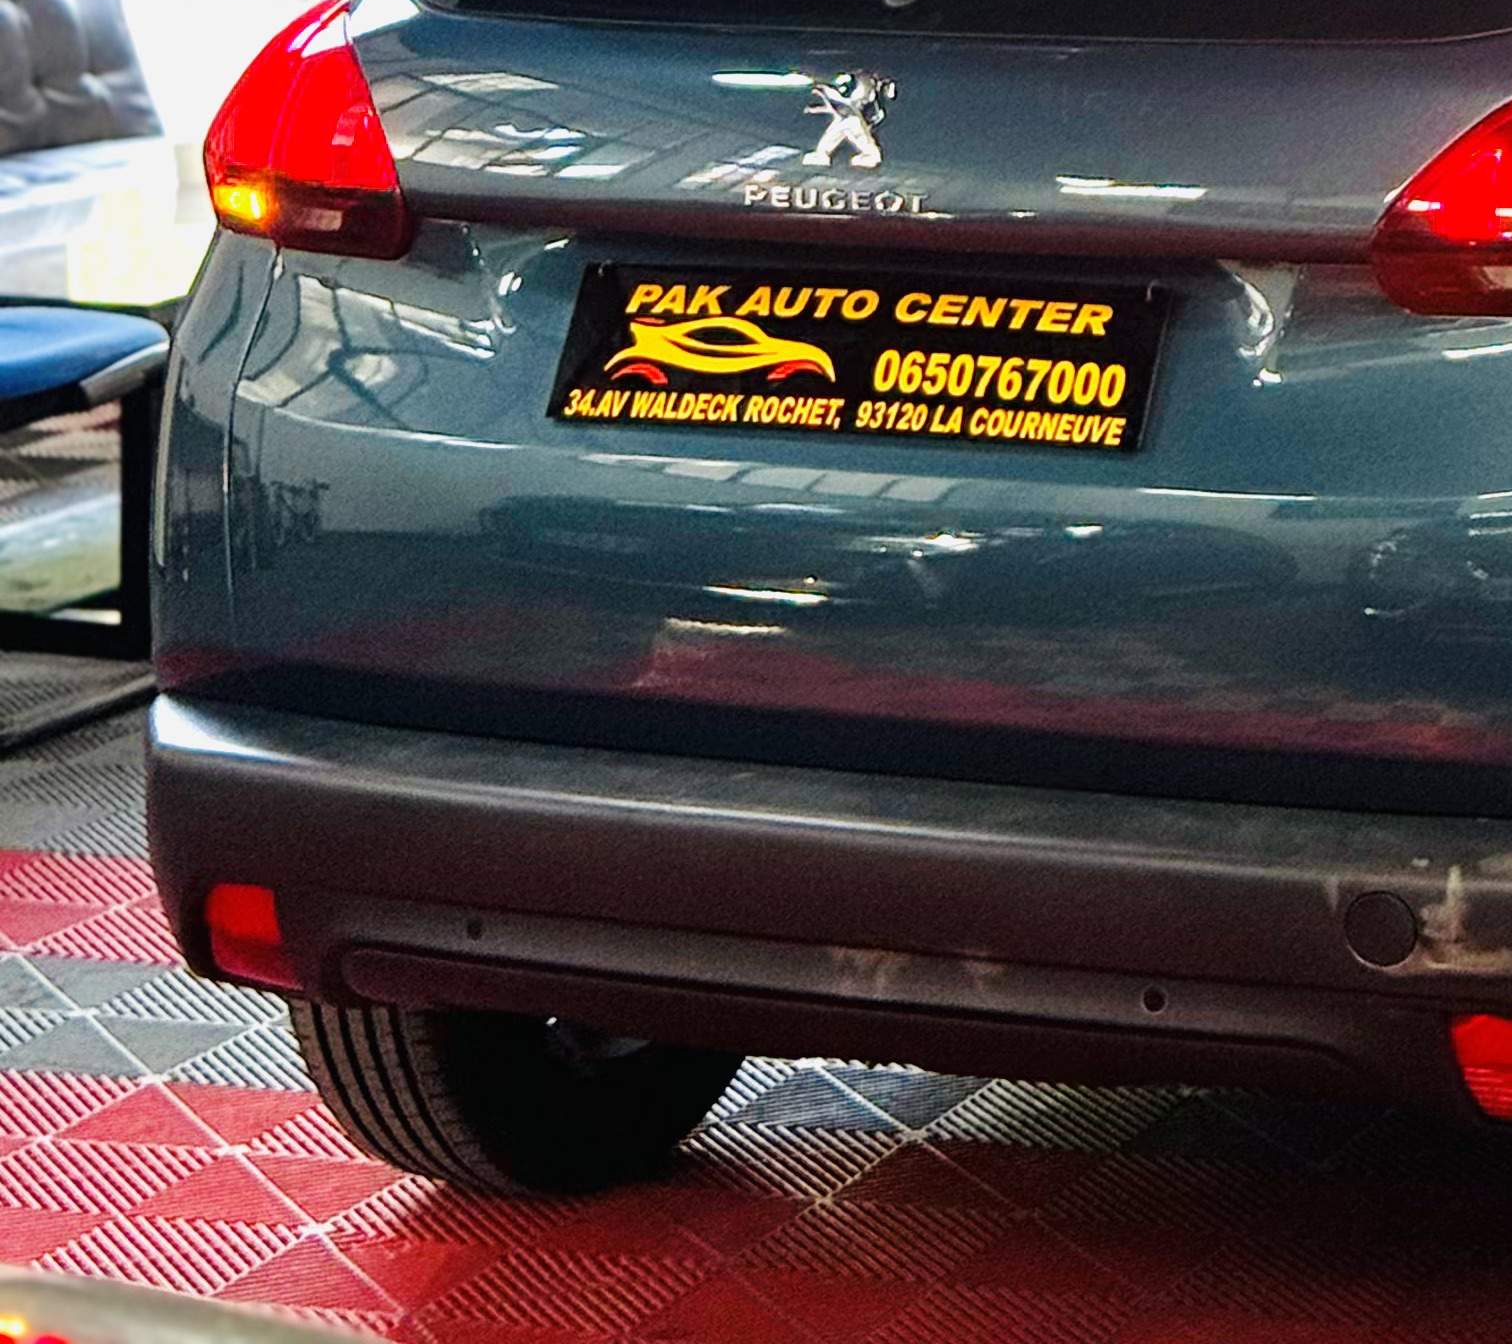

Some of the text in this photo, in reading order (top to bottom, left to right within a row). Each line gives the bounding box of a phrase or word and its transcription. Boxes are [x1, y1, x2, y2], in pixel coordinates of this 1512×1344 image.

[743, 184, 928, 213] PEUGEOT
[625, 283, 1114, 336] PAK AUTO CENTER
[873, 349, 1126, 408] 0650767000
[629, 391, 744, 422] WALDECK
[743, 397, 845, 430] ROCHET,
[855, 400, 929, 431] 93120
[929, 404, 965, 434] LA
[969, 407, 1127, 447] COURNEUVE
